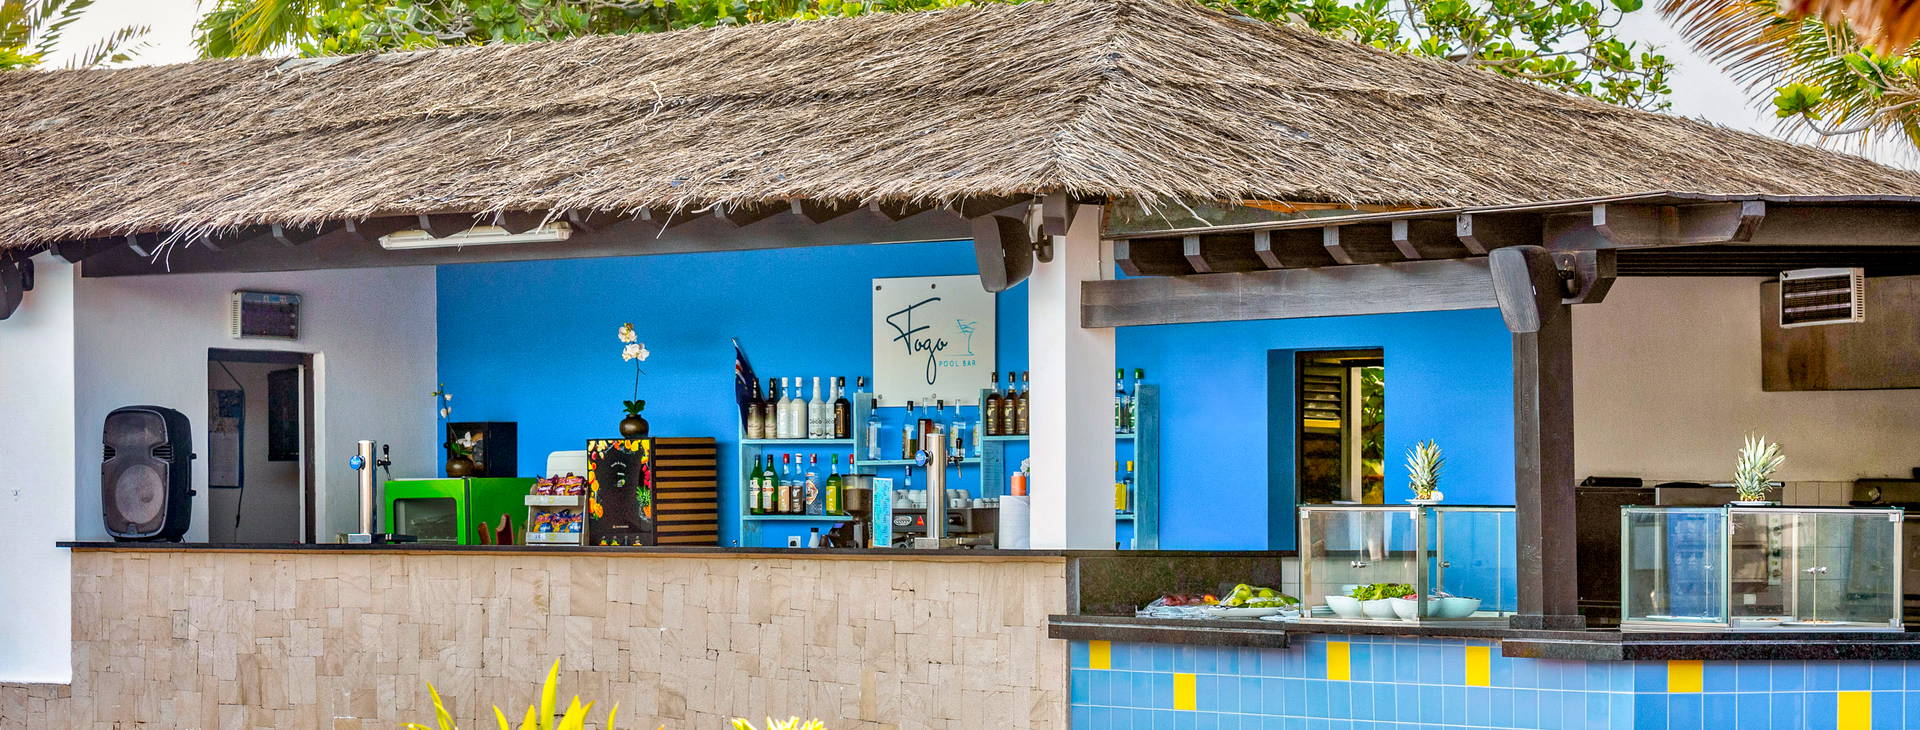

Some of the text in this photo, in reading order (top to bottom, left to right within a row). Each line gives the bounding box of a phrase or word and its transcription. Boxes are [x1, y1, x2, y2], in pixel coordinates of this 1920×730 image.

[886, 297, 948, 385] Fogo
[938, 360, 976, 368] POOL BAR
